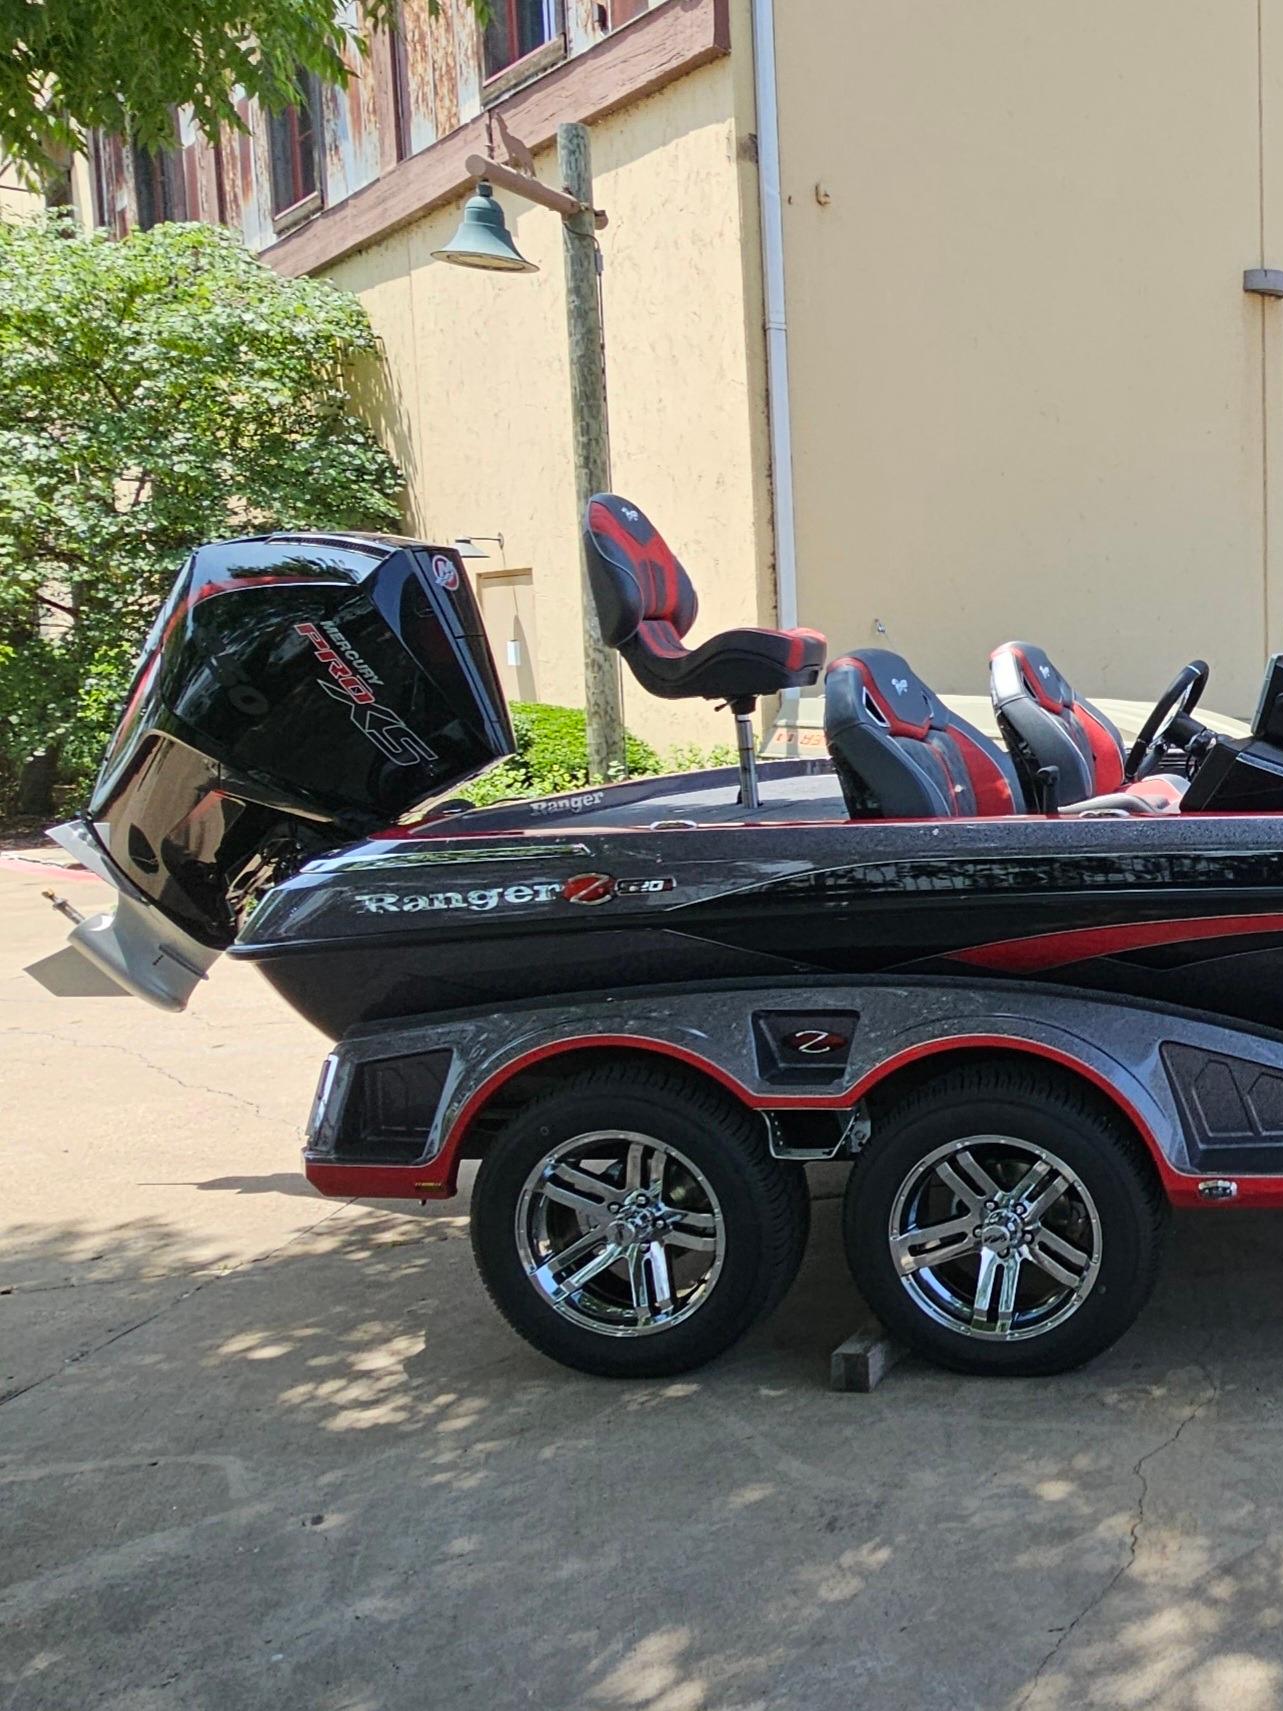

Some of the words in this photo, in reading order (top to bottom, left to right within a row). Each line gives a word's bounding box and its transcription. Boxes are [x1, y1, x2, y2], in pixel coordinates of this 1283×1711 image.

[293, 621, 376, 705] PRO
[319, 620, 385, 686] MERCURY
[316, 678, 440, 766] XS
[529, 790, 604, 817] Ranger
[354, 882, 563, 914] Ranger
